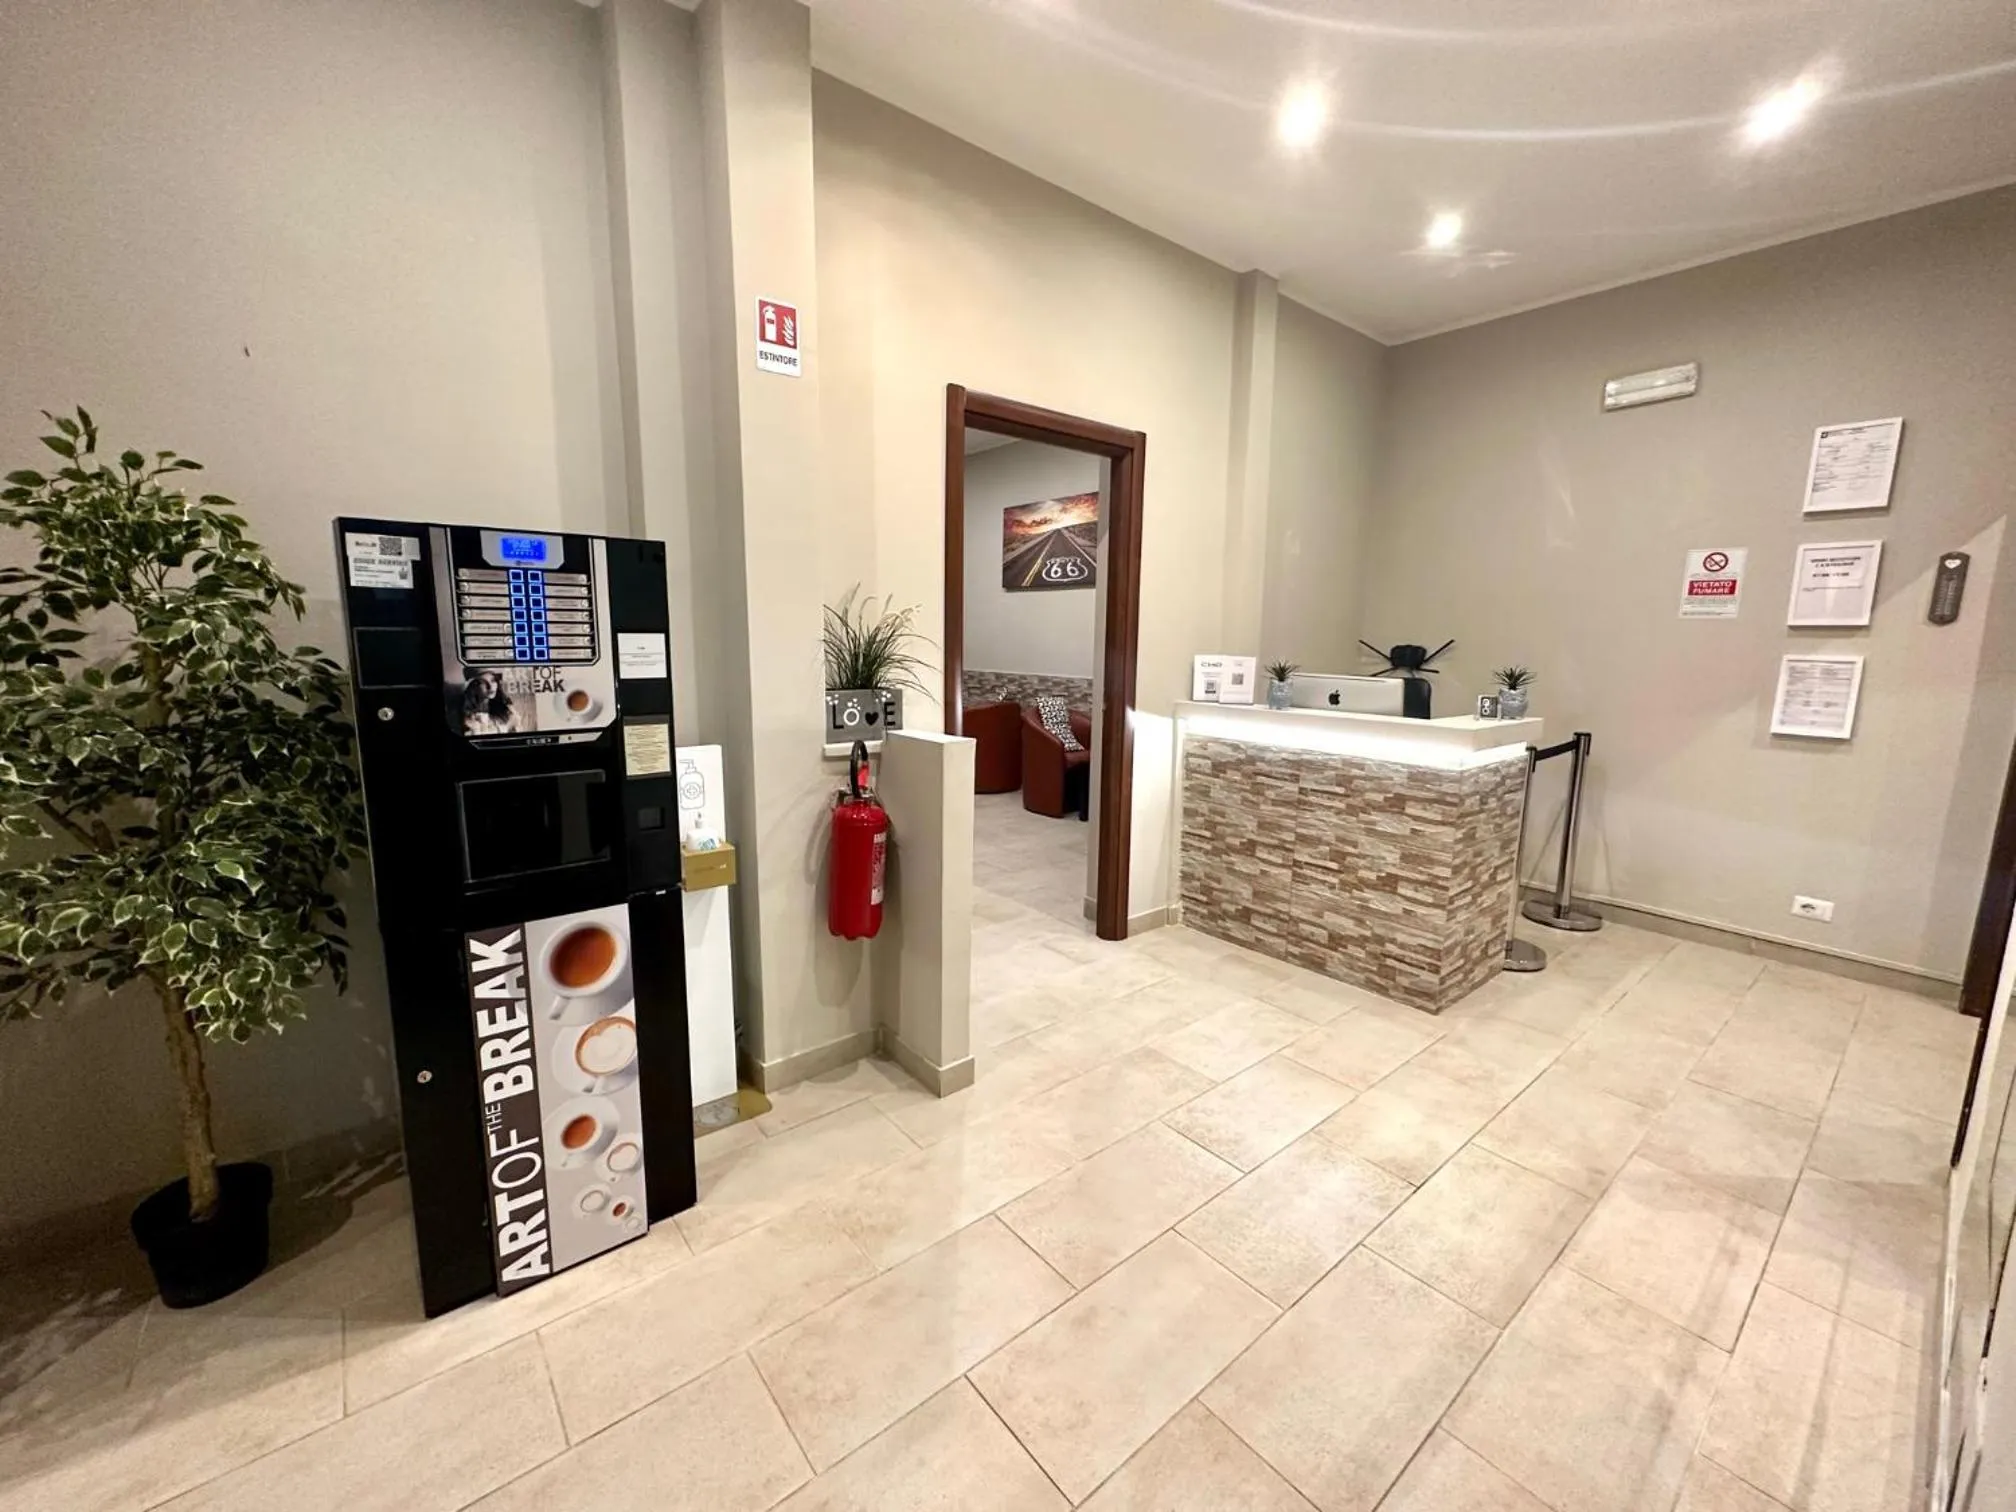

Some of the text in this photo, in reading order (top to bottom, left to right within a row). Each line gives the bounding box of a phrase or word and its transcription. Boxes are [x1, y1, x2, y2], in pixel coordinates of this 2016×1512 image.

[759, 350, 798, 366] ESTINTORE
[1050, 562, 1079, 578] 66
[1692, 587, 1731, 595] FUMARE
[506, 679, 565, 694] BREAK
[832, 701, 896, 729] LOE
[468, 928, 534, 1104] BREAK
[484, 1101, 503, 1136] THE
